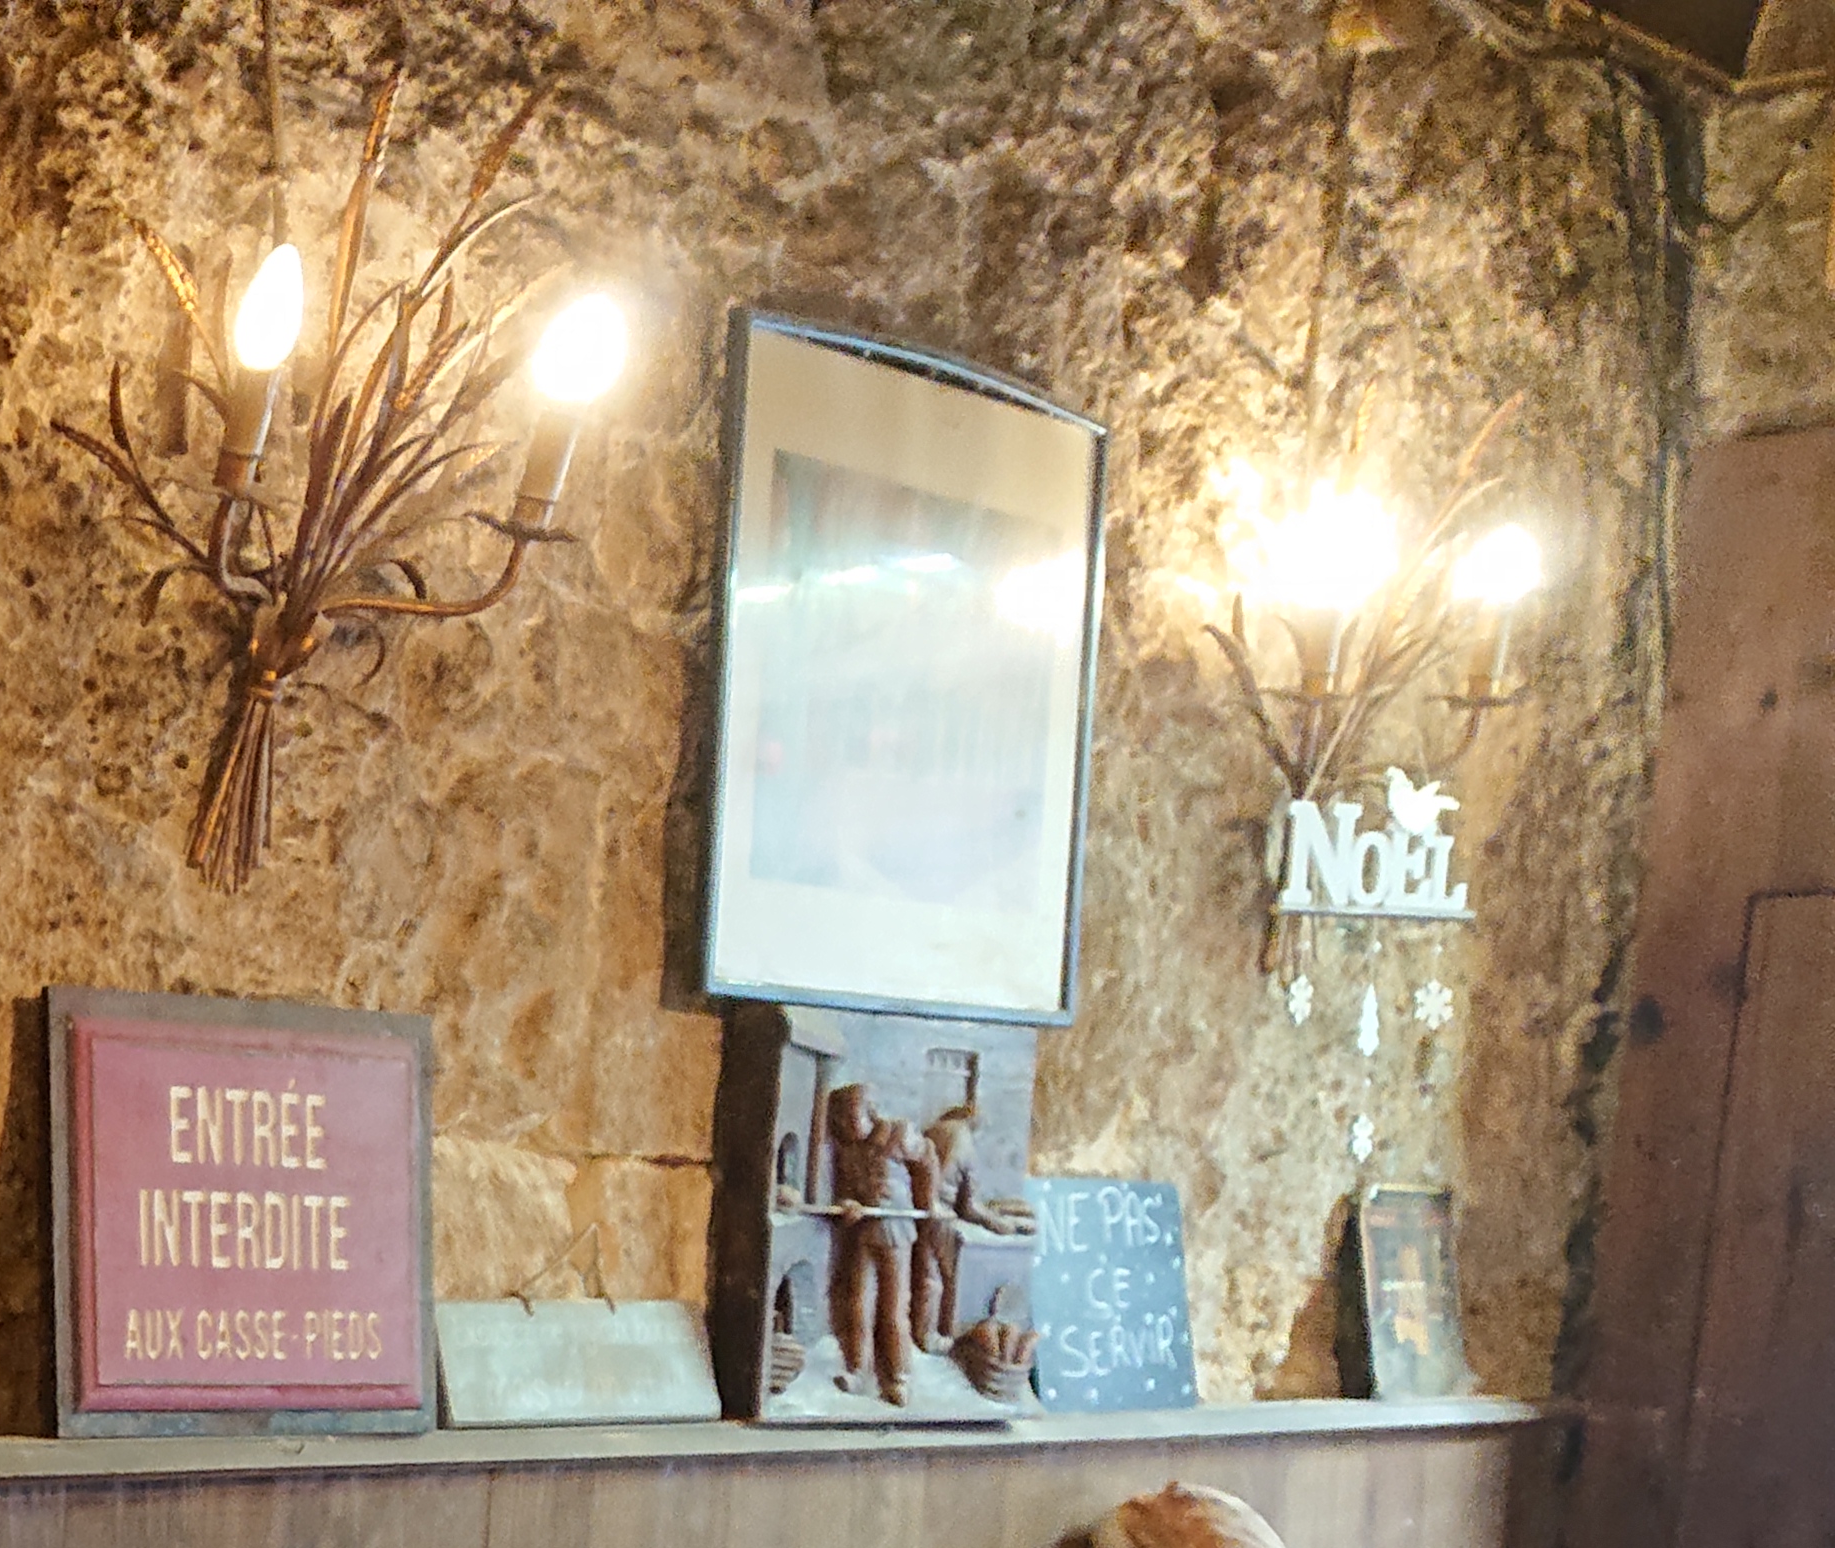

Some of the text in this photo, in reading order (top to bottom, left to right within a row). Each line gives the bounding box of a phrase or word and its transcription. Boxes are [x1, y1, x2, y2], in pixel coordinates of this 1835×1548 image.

[169, 1079, 328, 1170] ENTRÉE
[139, 1189, 350, 1271] INTERDITE
[1036, 1185, 1163, 1256] NE PAS
[124, 1309, 185, 1361] AUX
